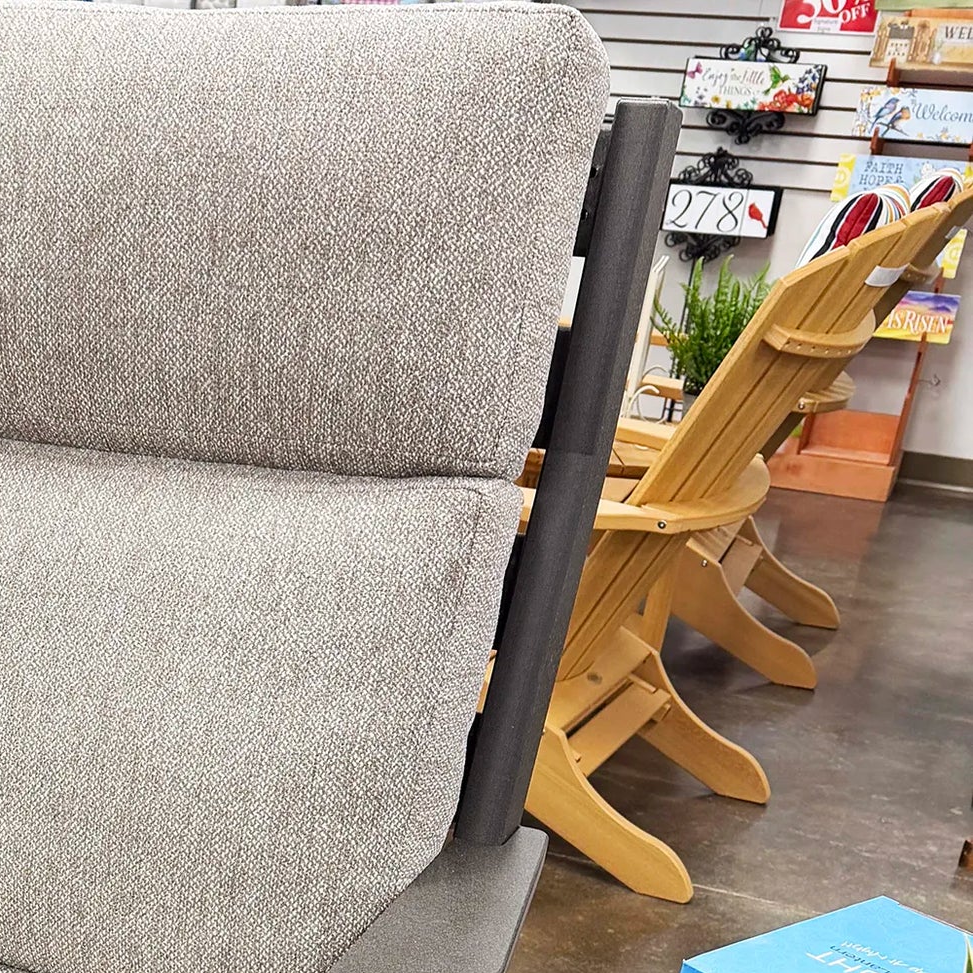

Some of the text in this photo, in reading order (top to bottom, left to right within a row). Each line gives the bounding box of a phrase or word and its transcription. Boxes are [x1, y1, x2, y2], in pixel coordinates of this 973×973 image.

[839, 3, 870, 23] OFF
[944, 26, 973, 40] WEL
[702, 67, 728, 87] Enjoy
[718, 85, 752, 96] THINGS
[912, 103, 973, 121] Welcom
[864, 161, 903, 174] FAITH
[666, 189, 744, 232] 278
